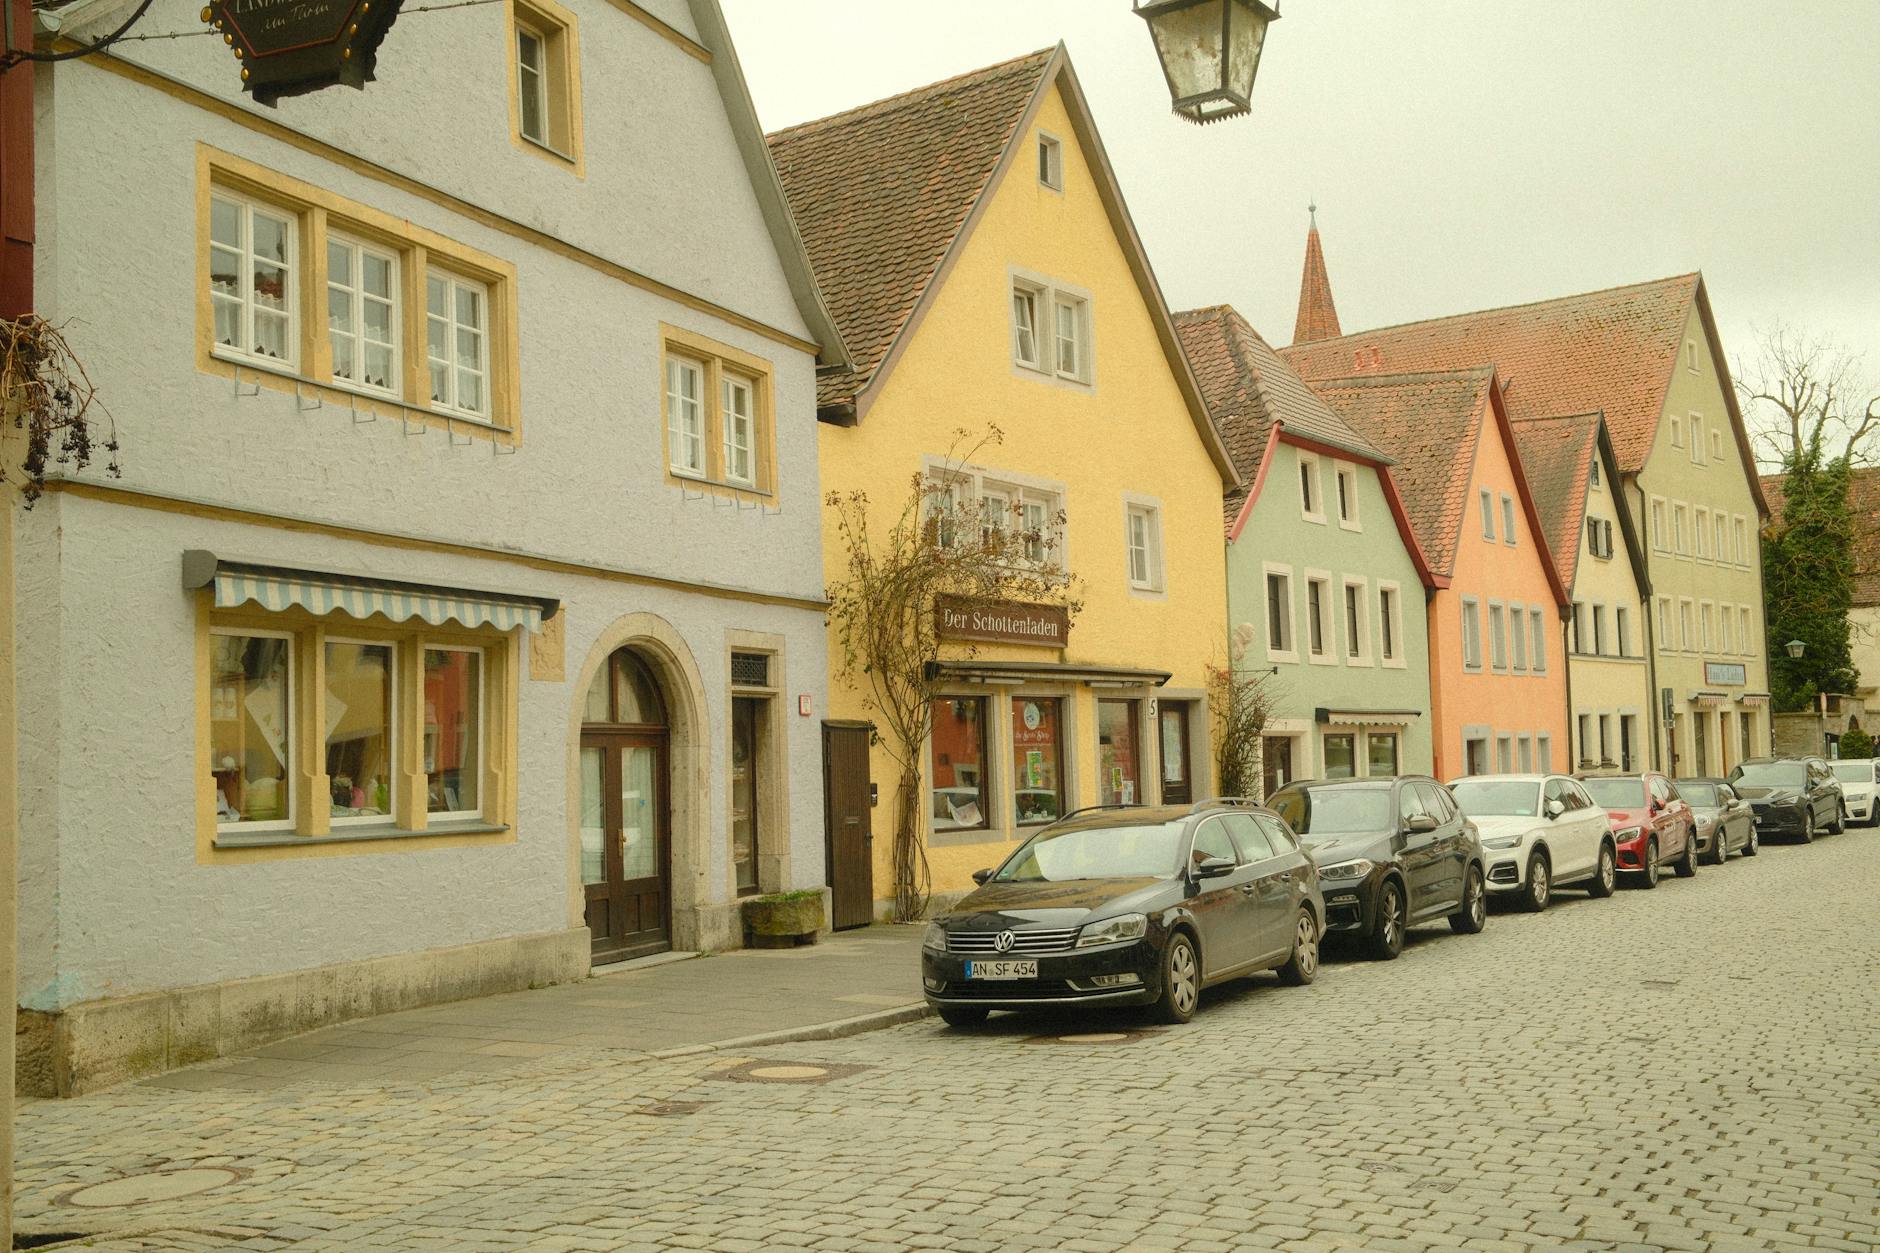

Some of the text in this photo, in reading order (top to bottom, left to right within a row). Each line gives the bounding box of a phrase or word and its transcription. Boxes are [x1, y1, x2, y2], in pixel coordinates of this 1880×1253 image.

[944, 608, 1059, 637] Der Schottenladen
[1150, 699, 1157, 716] 5
[972, 962, 1036, 976] AN SF 454
